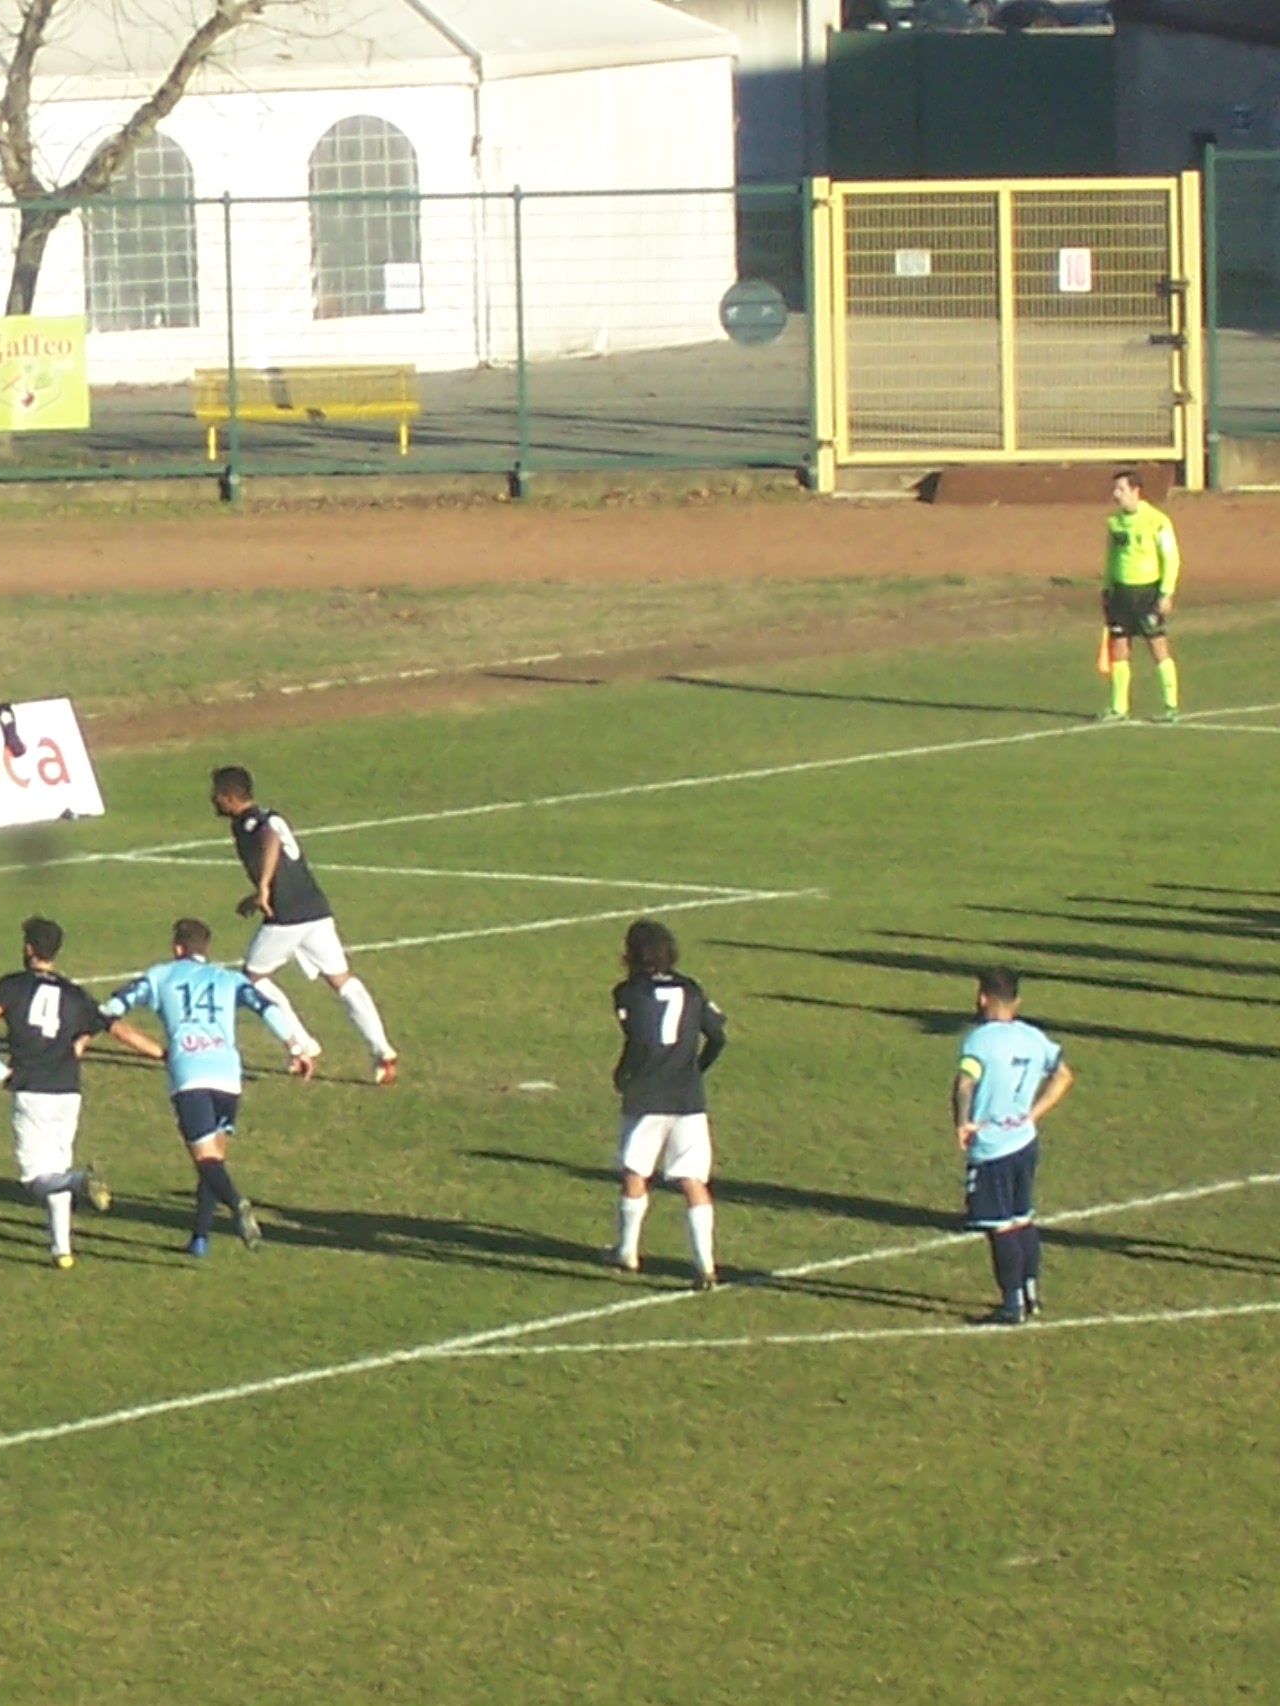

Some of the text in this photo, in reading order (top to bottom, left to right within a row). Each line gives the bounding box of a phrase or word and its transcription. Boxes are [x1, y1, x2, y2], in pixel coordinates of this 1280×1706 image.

[27, 983, 62, 1039] 4
[175, 981, 225, 1024] 14
[654, 986, 684, 1045] 7
[1011, 1056, 1031, 1099] 7
